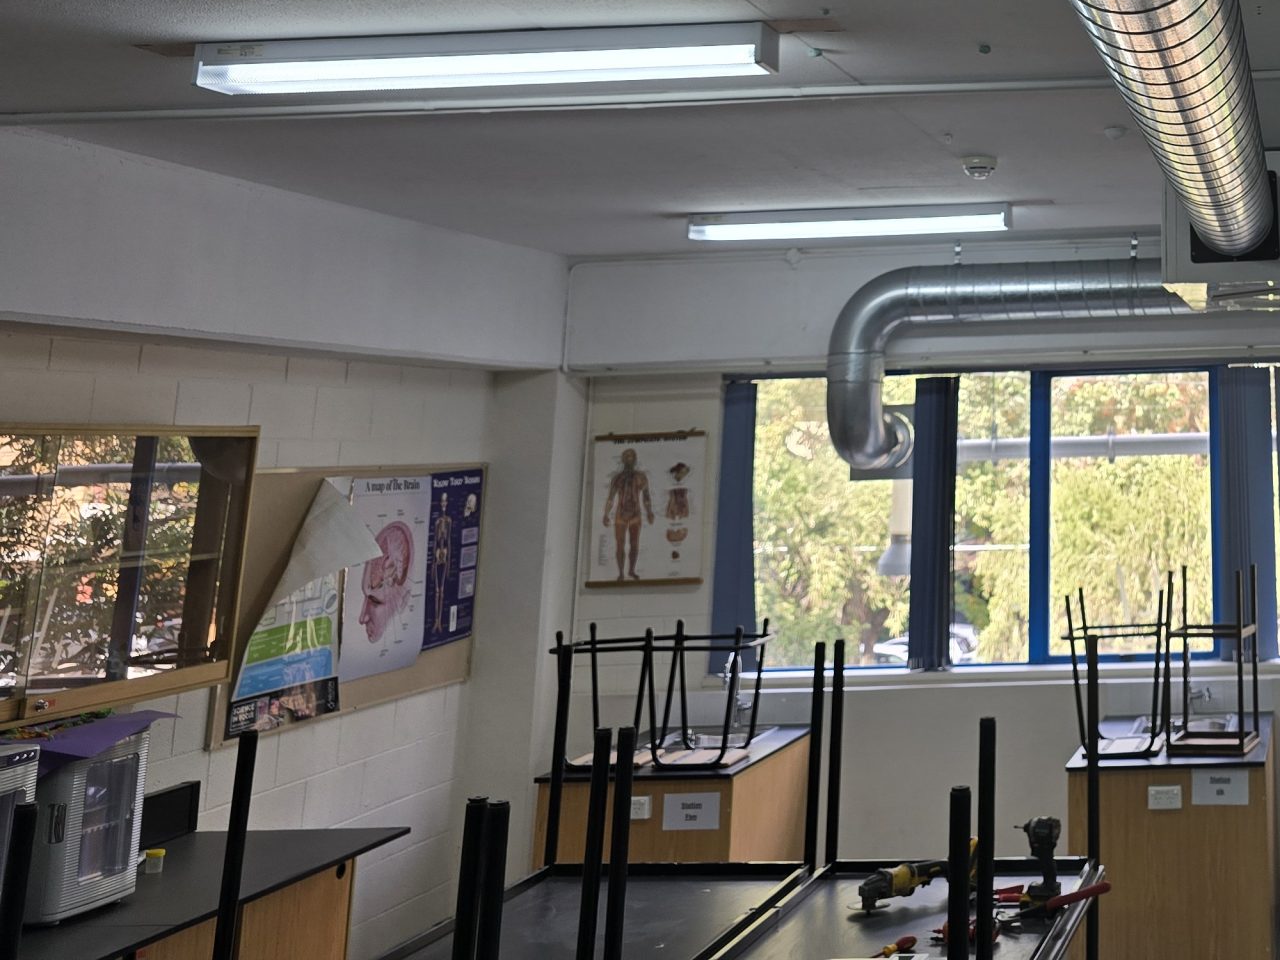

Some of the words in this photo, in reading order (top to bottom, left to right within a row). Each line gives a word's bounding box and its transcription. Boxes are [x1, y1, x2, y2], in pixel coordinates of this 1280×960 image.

[365, 481, 371, 492] A
[371, 483, 385, 493] map
[403, 479, 420, 490] Brain
